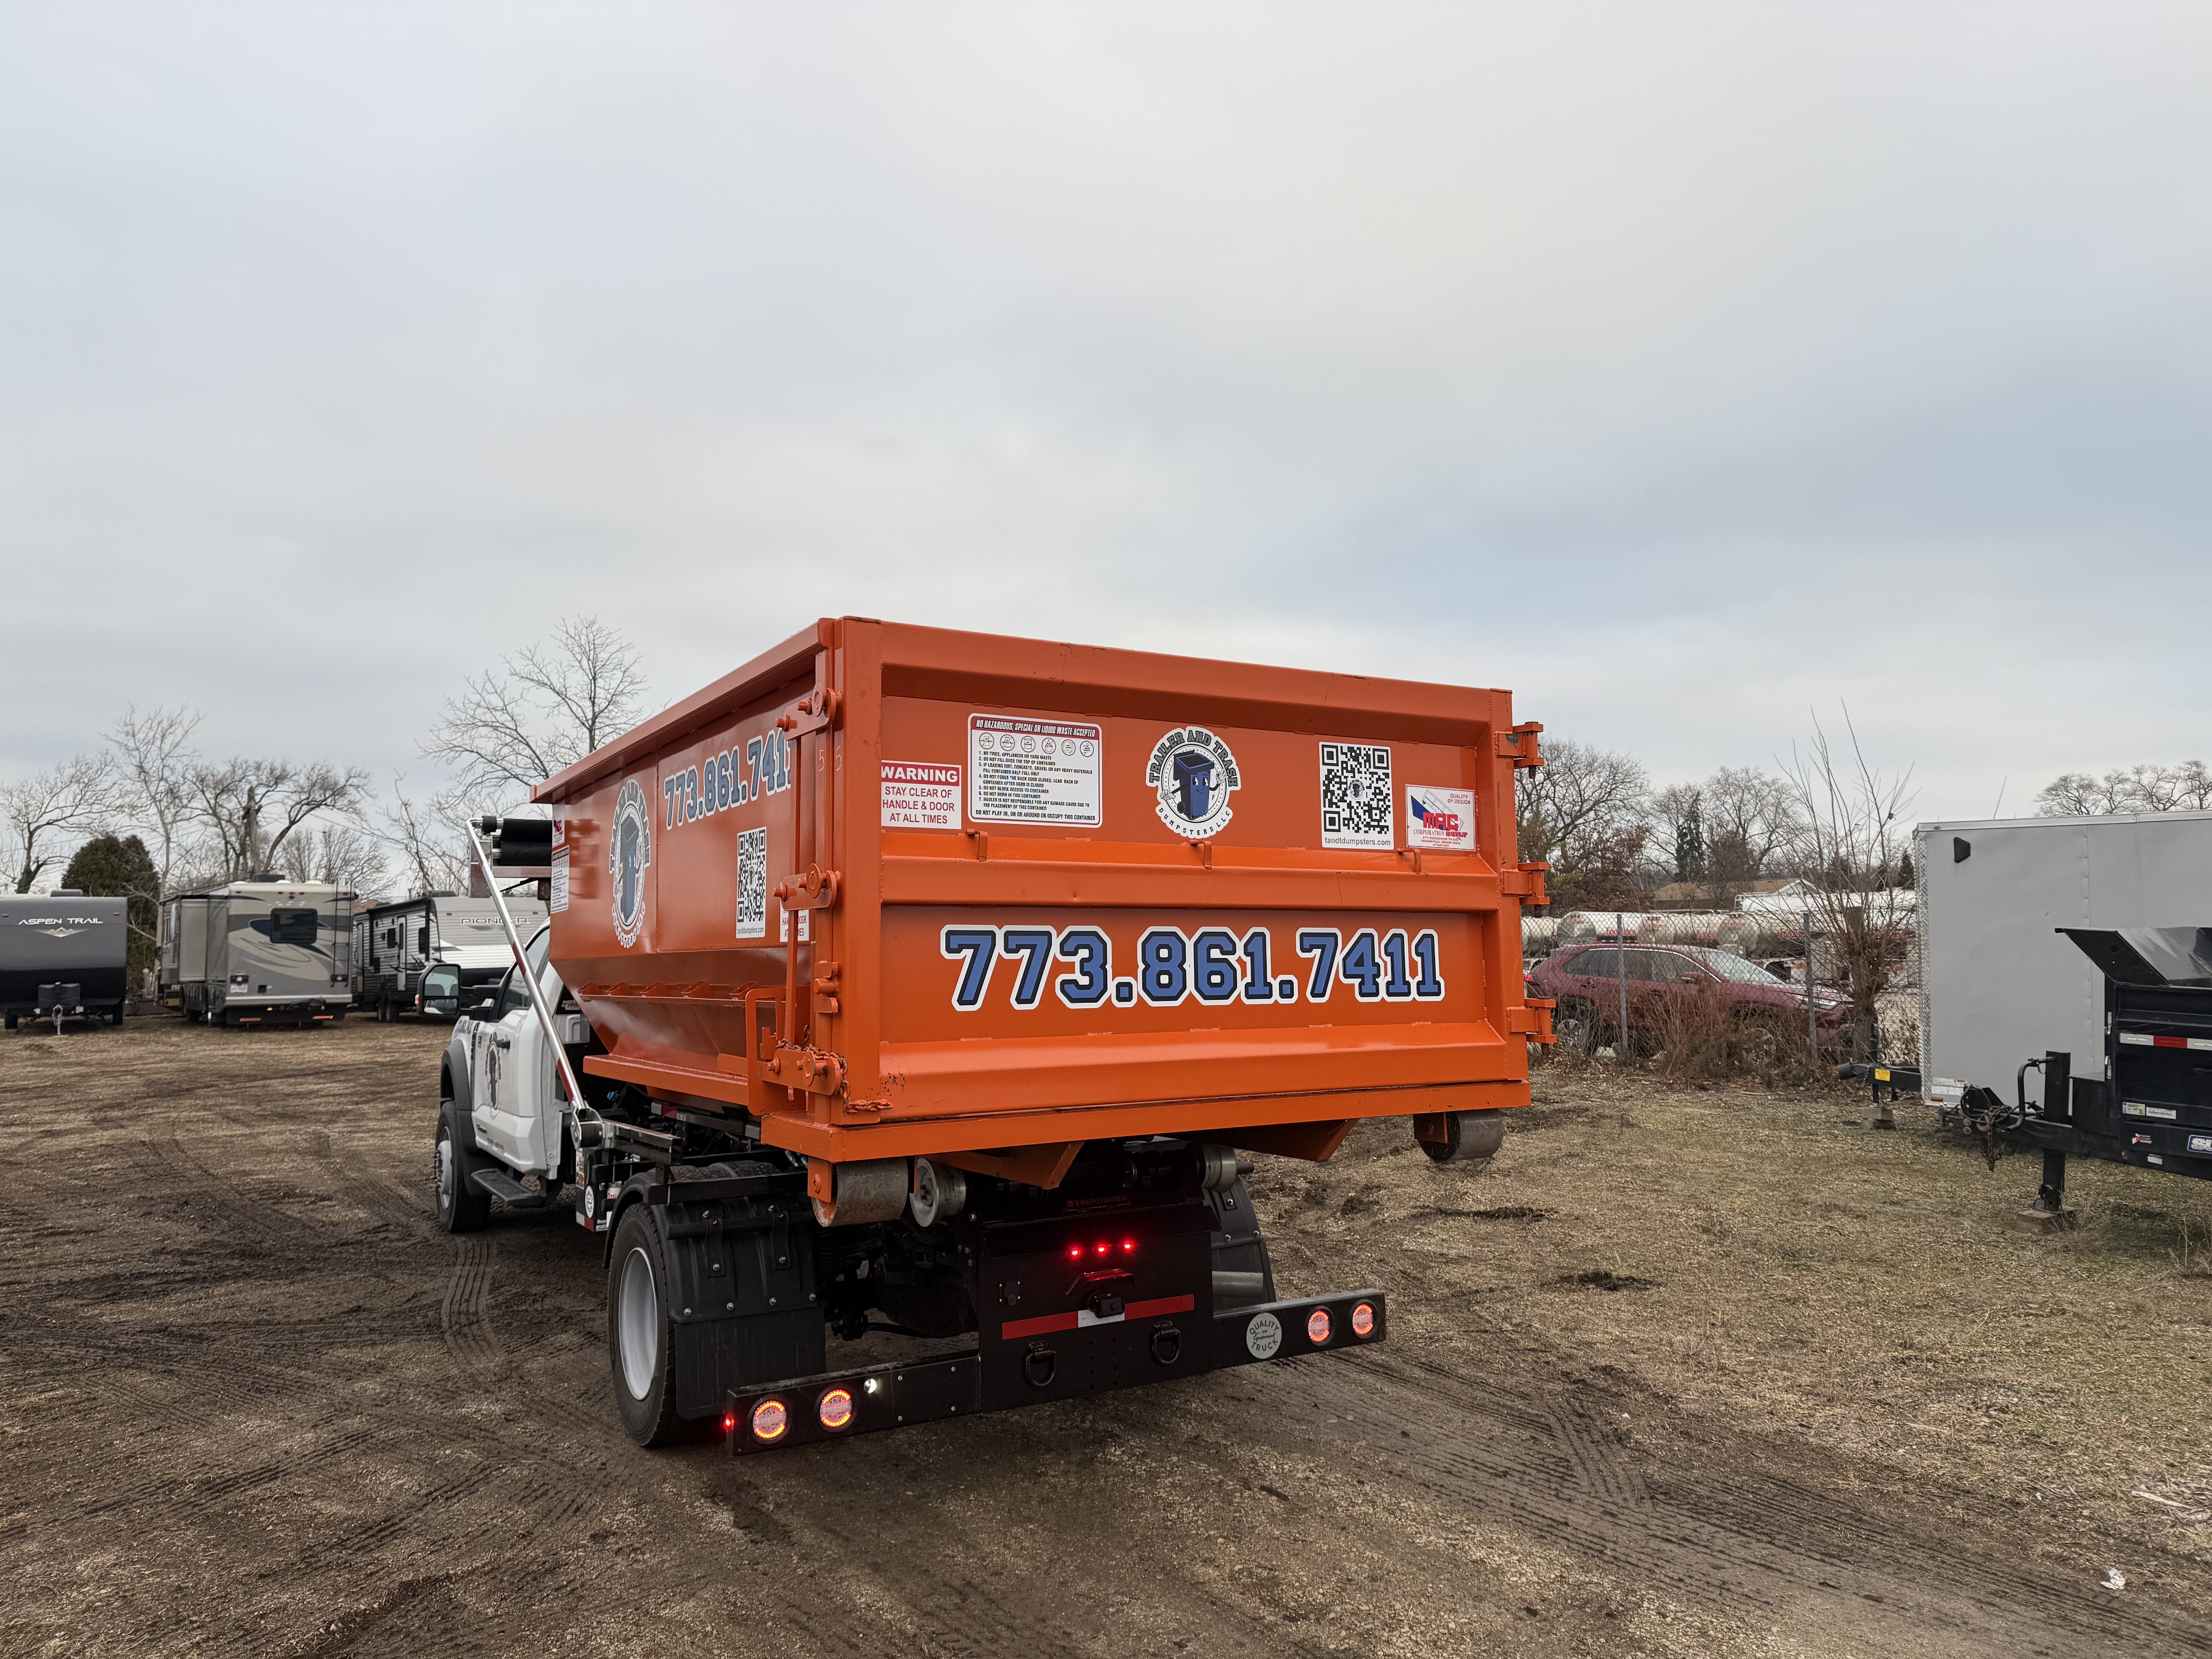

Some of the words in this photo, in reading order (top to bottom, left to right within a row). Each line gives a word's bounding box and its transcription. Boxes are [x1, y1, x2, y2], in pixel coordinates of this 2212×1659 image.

[976, 719, 984, 728] NO
[1015, 723, 1033, 732] SPECIAL
[1034, 724, 1041, 732] OR
[1057, 726, 1073, 735] WASTE
[1149, 732, 1185, 783] TRAILER
[1187, 730, 1212, 746] AND
[1214, 740, 1238, 787] TRASH
[881, 766, 958, 783] WARNING
[885, 786, 907, 796] STAY
[909, 788, 938, 797] CLEAR
[941, 789, 952, 798] OF
[883, 799, 918, 809] HANDLE
[921, 801, 927, 810] &
[930, 802, 955, 811] DOOR
[890, 813, 901, 822] AT
[903, 814, 919, 823] ALL
[922, 814, 947, 824] TIMES
[1159, 808, 1214, 835] DUMPSTERS
[1216, 811, 1230, 827] LLC
[1423, 812, 1458, 831] MAC
[1325, 836, 1391, 847] tandtdumpsters.com
[942, 926, 1444, 1010] 773.861.7411
[1250, 1320, 1279, 1334] QUALITY
[1252, 1338, 1278, 1351] TRUCK
